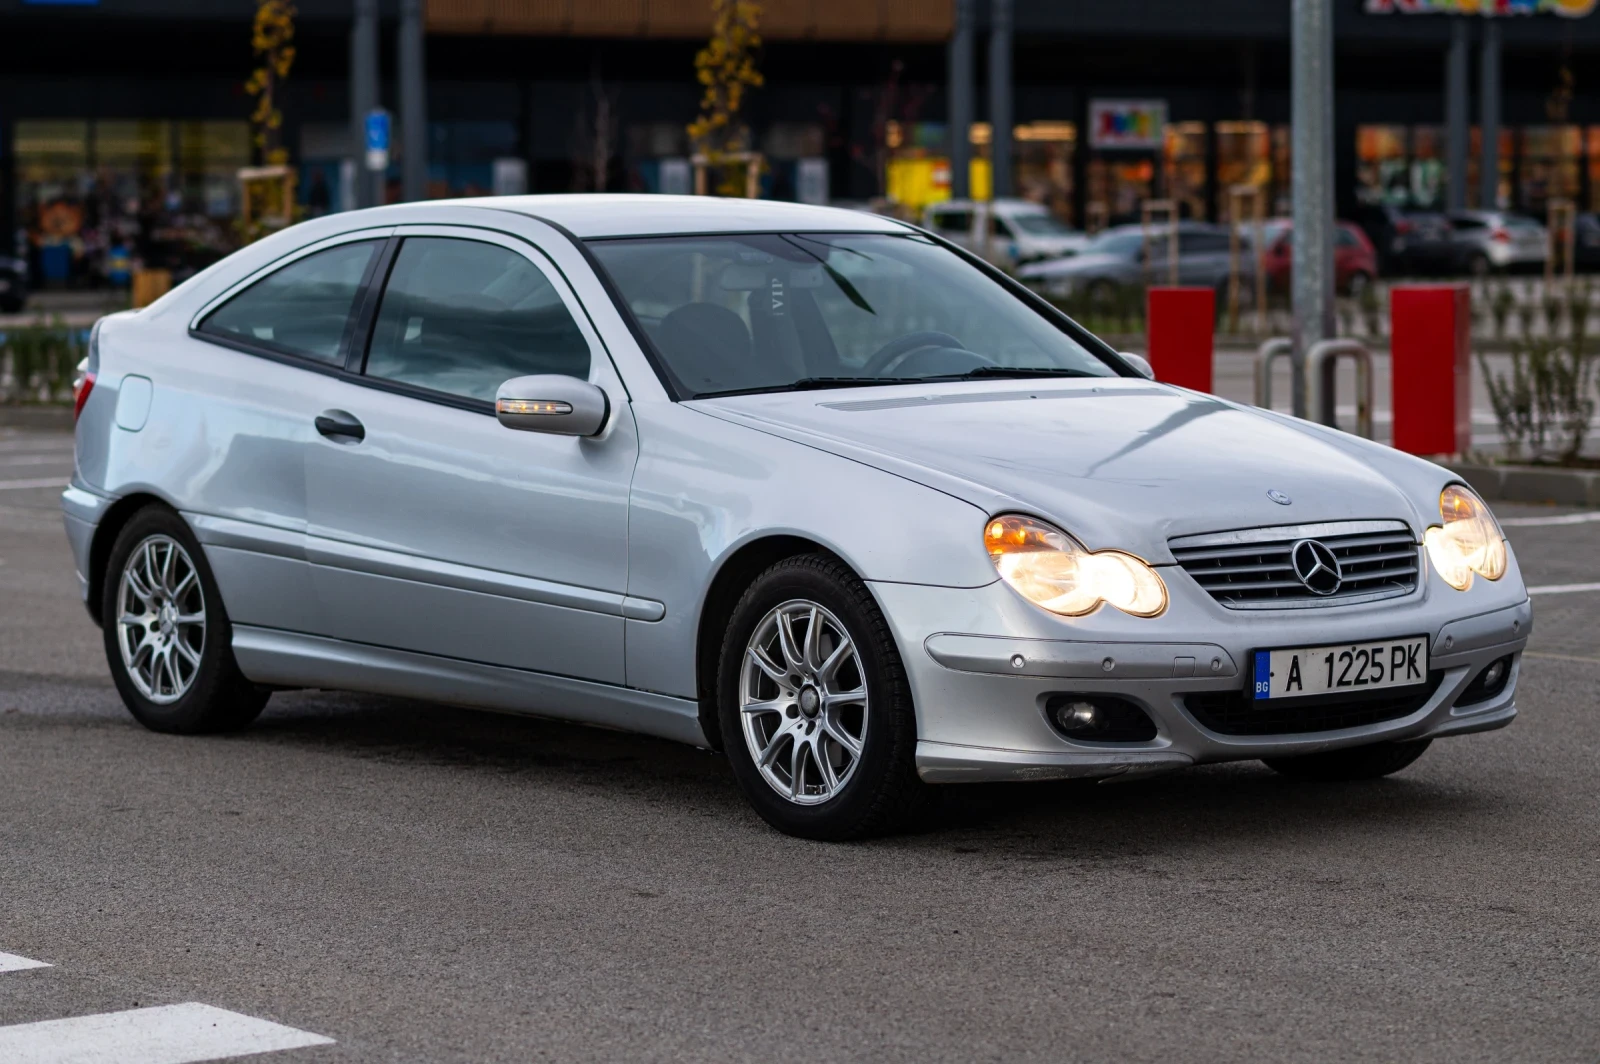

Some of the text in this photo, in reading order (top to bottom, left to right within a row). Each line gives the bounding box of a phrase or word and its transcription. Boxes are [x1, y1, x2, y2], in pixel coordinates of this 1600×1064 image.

[771, 278, 784, 310] VIP
[1285, 643, 1421, 691] A 1225 PK
[1256, 682, 1269, 693] BG
